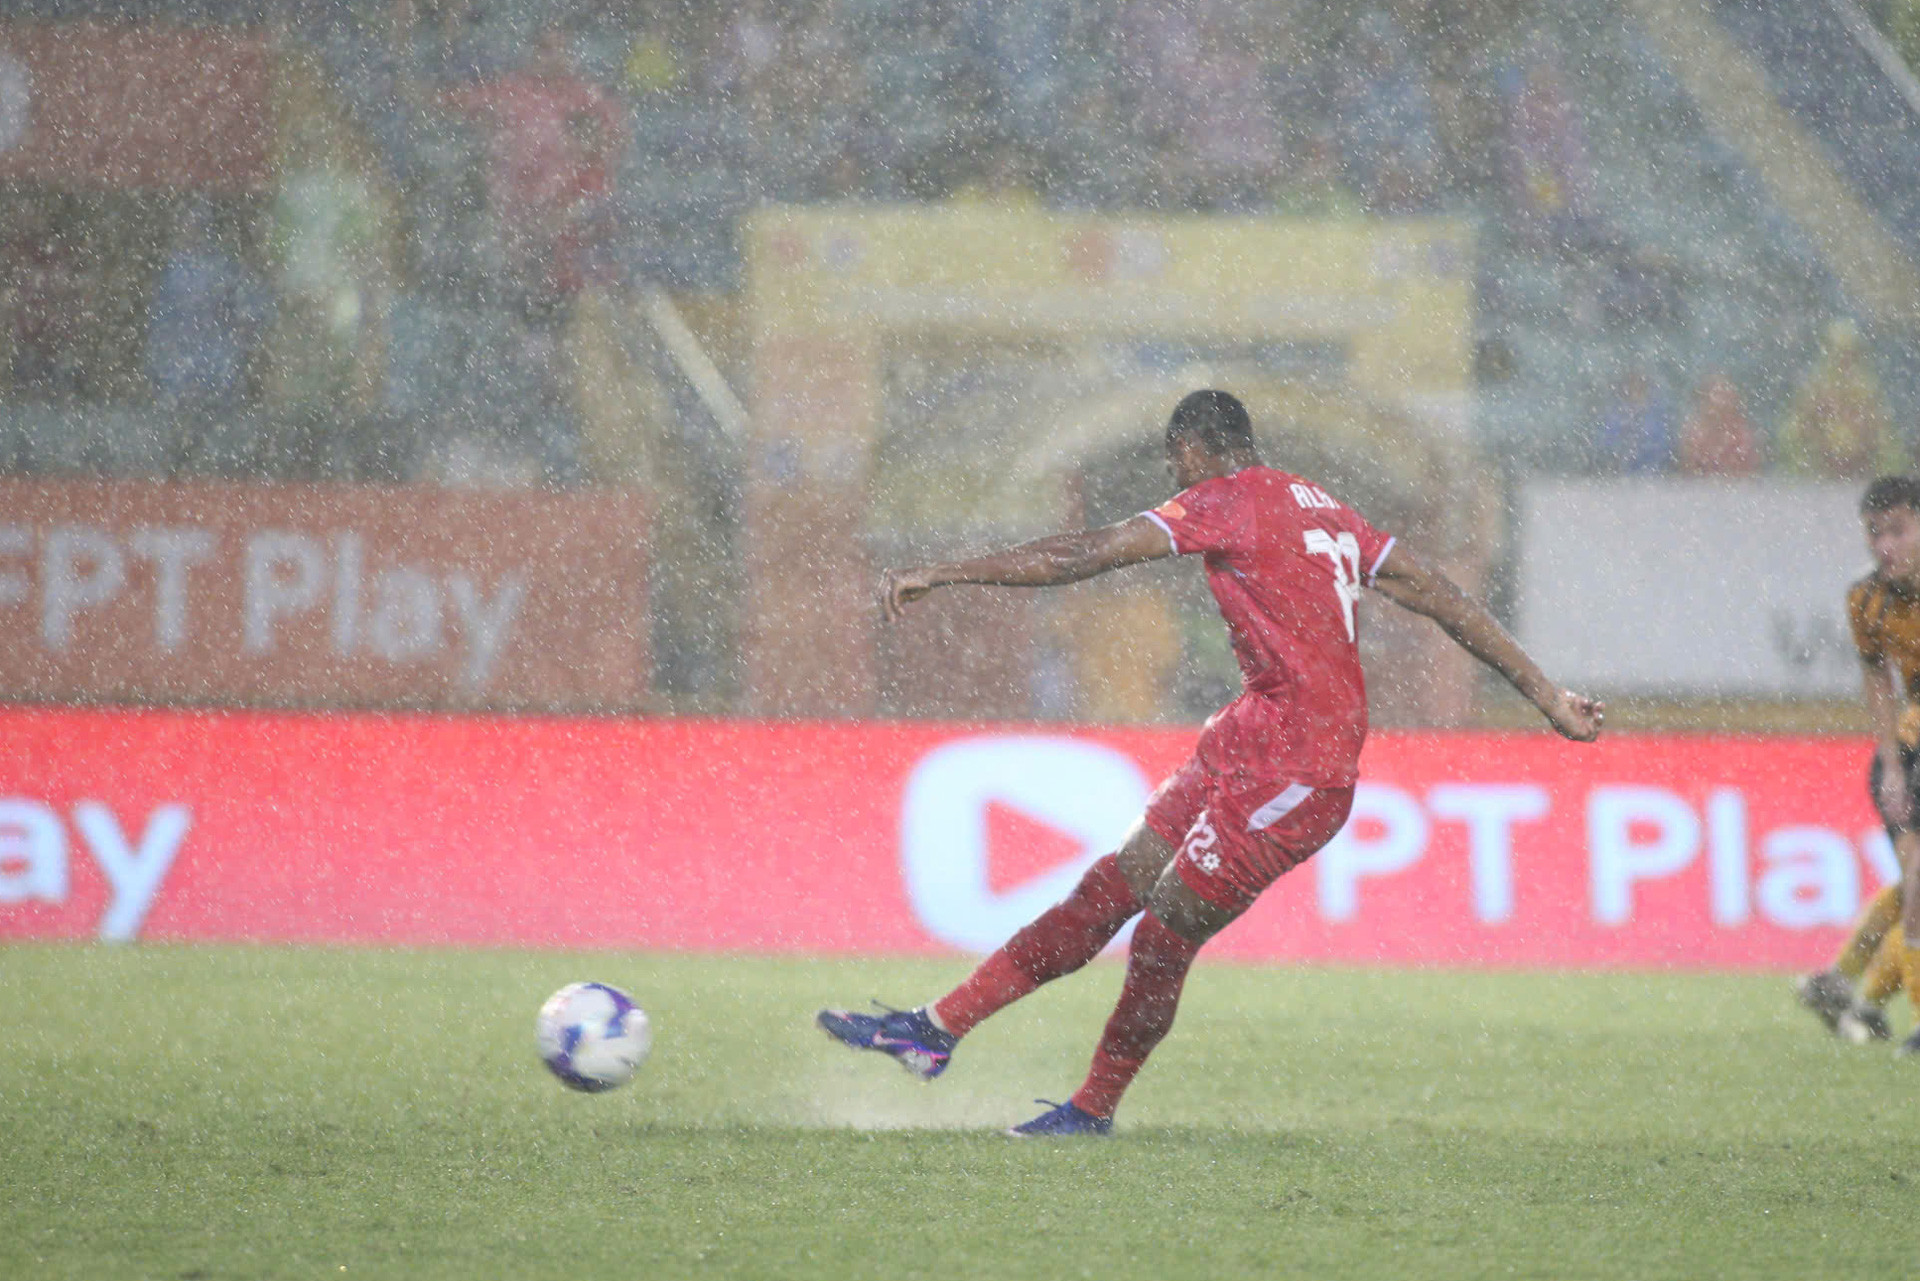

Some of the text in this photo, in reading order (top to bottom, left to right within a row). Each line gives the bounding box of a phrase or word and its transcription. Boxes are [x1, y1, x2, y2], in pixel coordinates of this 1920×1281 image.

[1289, 483, 1341, 509] ALA
[242, 528, 530, 694] Play
[1315, 782, 1551, 924] PT
